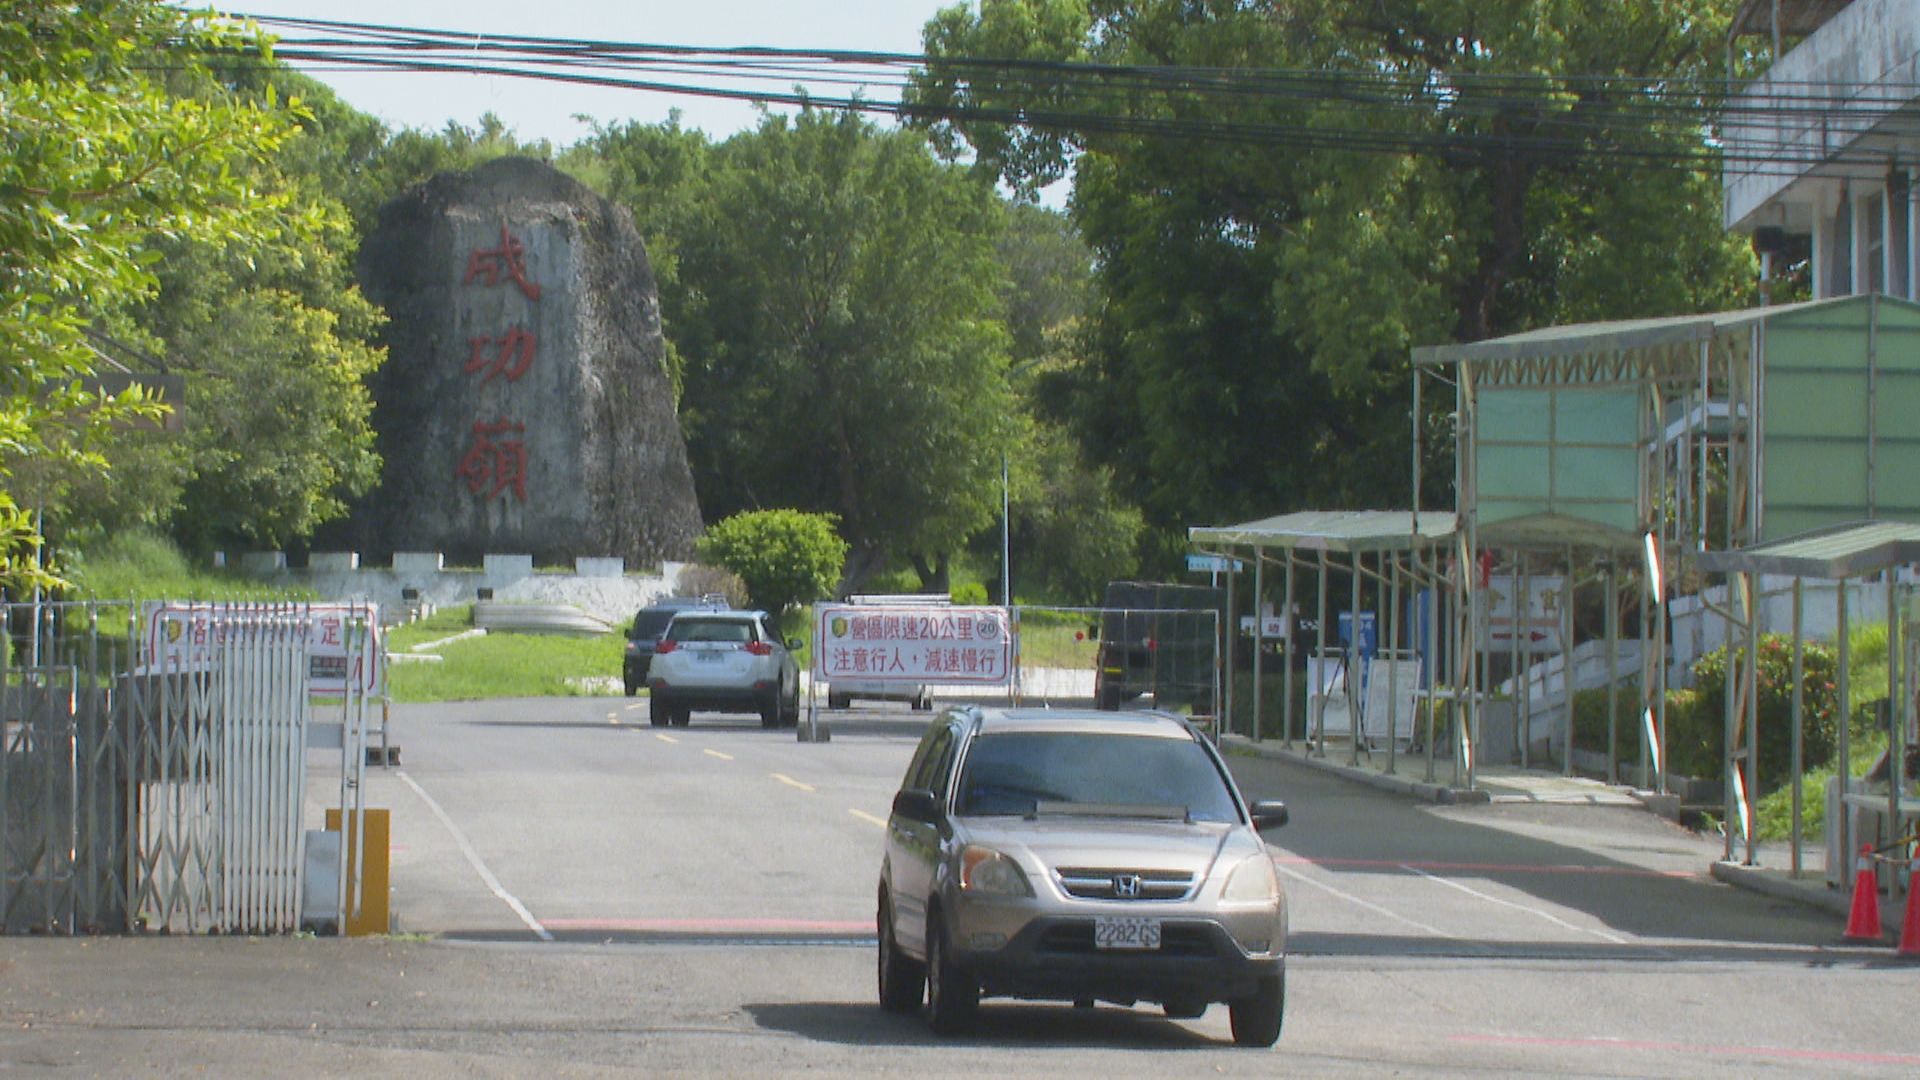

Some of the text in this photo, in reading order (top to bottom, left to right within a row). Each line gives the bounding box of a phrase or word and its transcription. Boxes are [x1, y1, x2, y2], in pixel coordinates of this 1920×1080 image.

[459, 218, 541, 503] 成功嶺
[851, 616, 974, 641] 營區限速20公里
